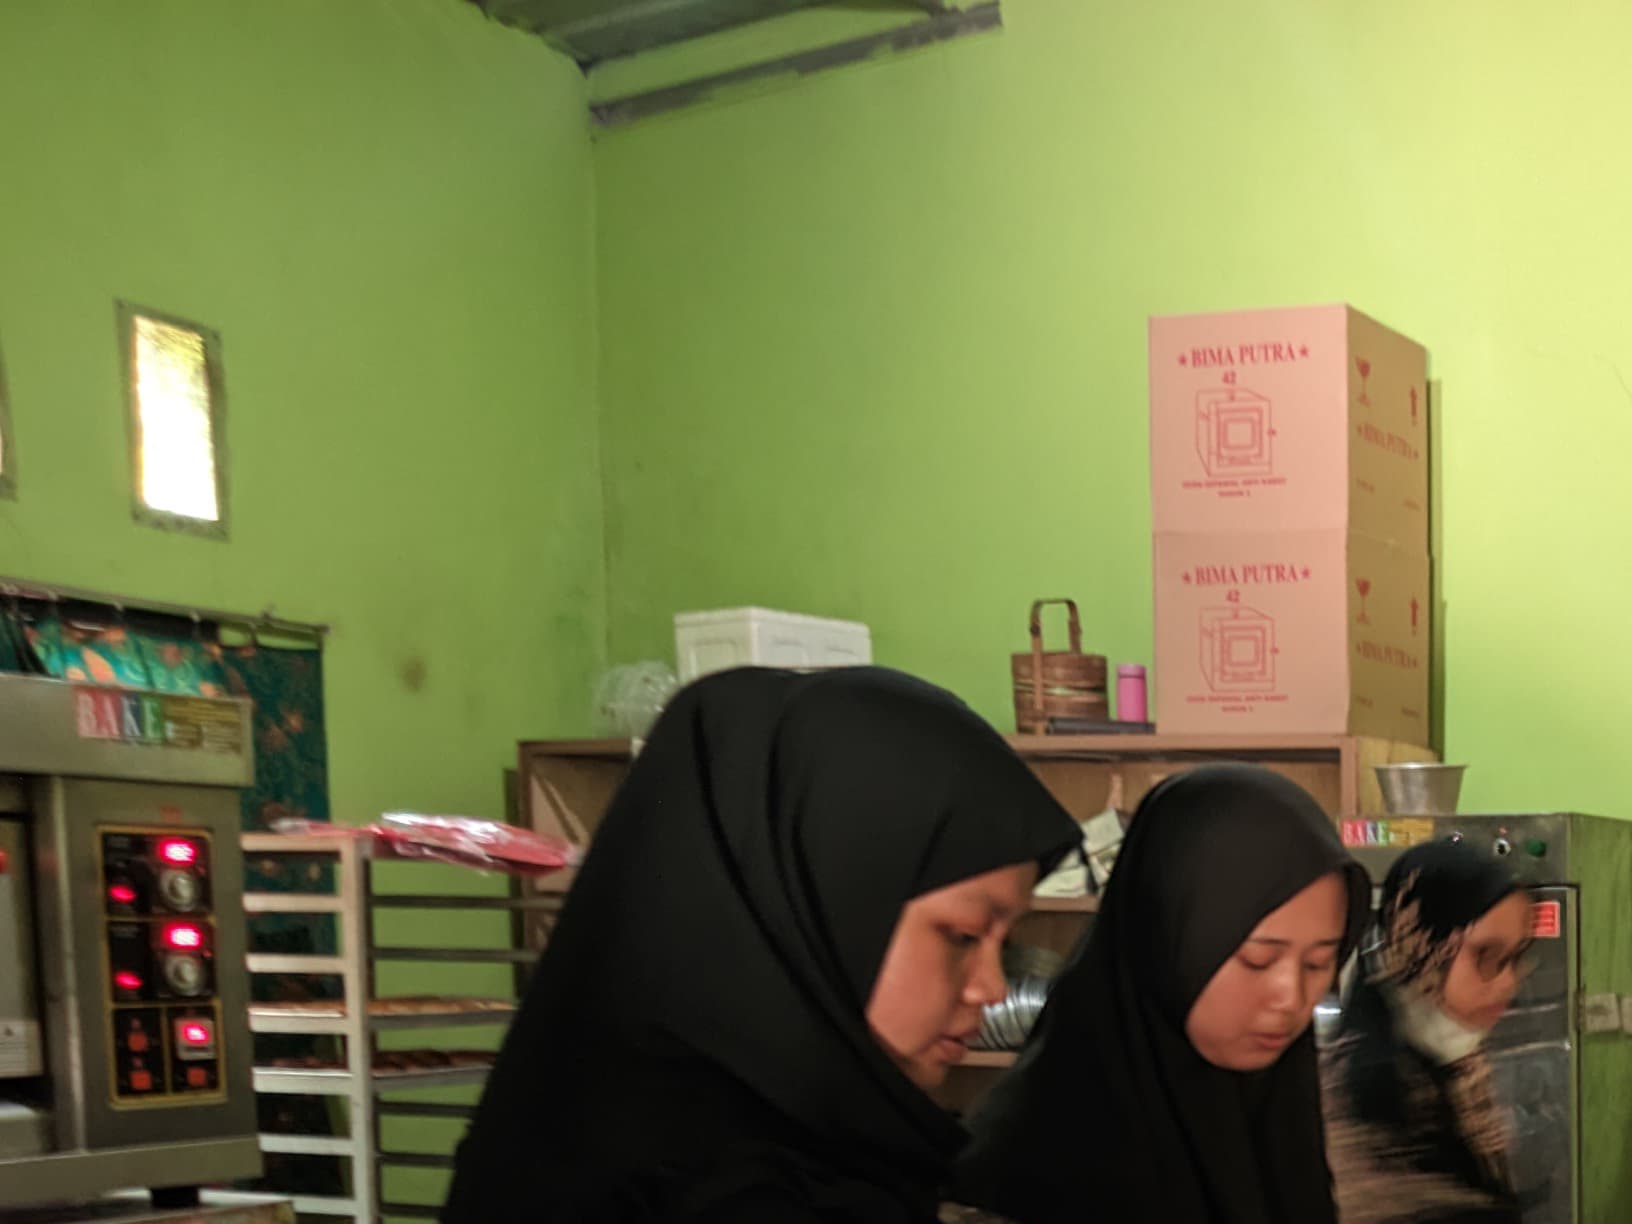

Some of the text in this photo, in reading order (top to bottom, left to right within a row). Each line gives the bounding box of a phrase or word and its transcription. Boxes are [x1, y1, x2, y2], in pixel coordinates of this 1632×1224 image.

[1191, 342, 1296, 367] BIMA PUTRA
[1195, 563, 1298, 586] BIMA PUTRA
